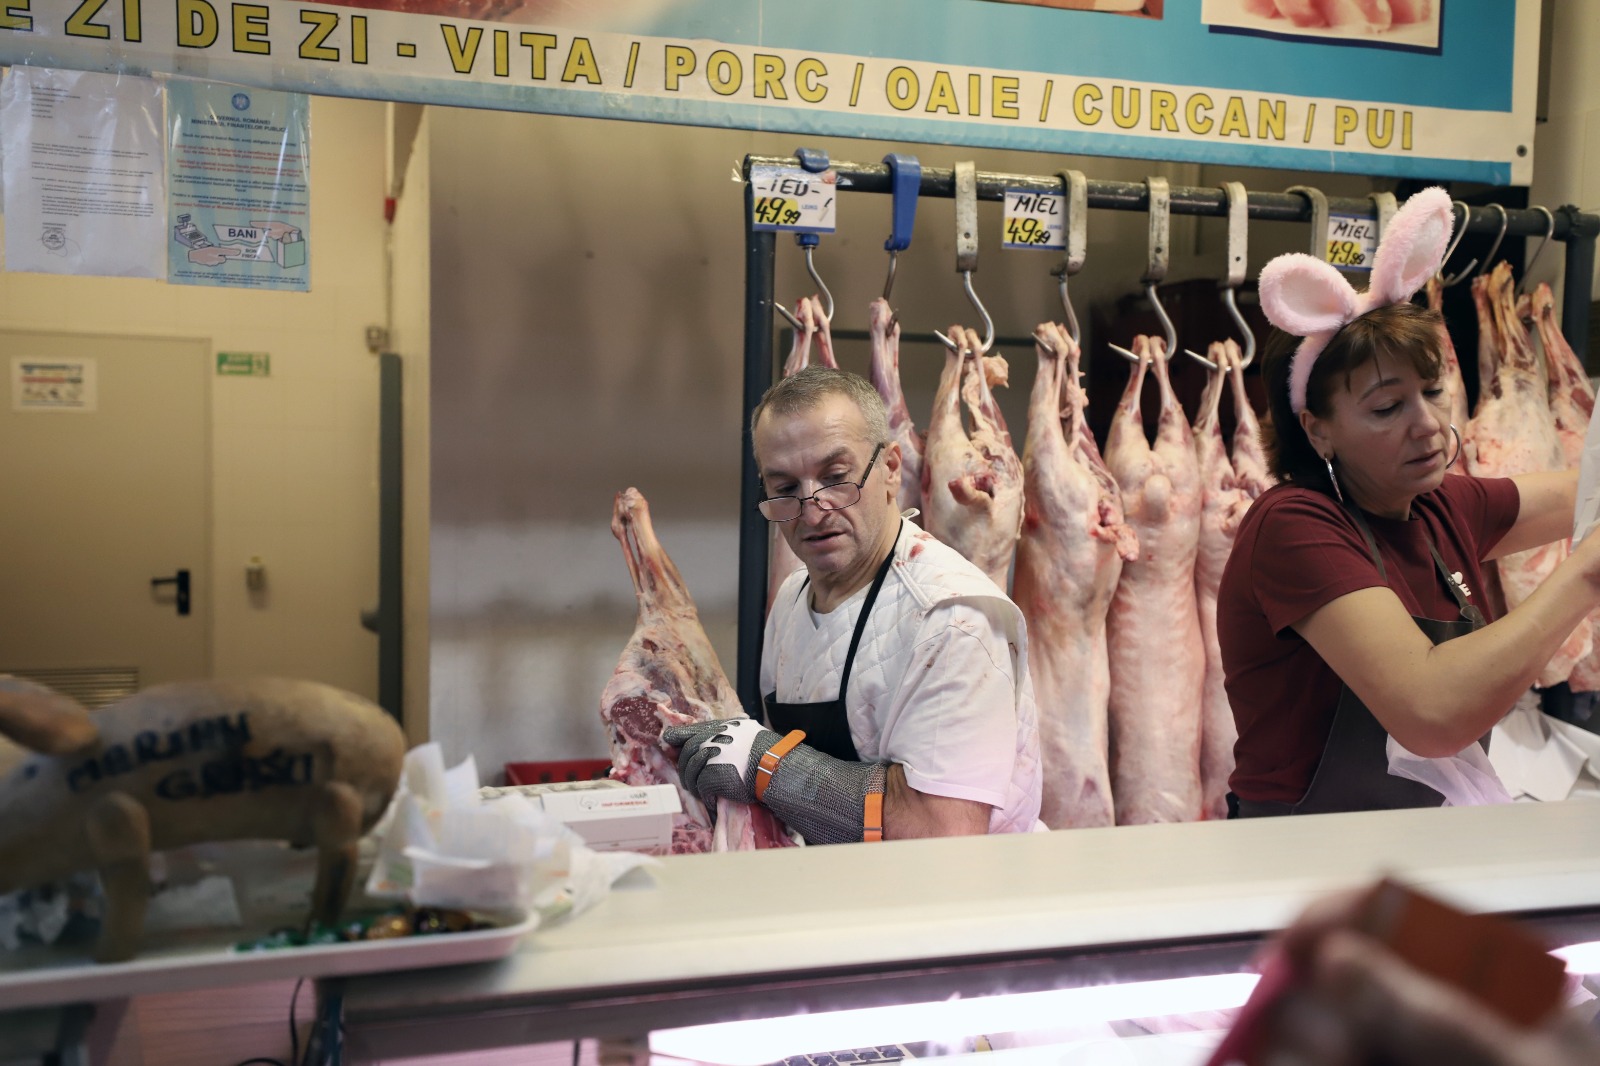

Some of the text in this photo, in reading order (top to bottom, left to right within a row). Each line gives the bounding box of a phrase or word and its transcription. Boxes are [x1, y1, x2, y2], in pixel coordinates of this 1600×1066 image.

[65, 0, 142, 42] ZI
[176, 0, 271, 55] DE
[298, 9, 368, 64] ZI
[396, 42, 417, 58] -
[440, 23, 602, 84] VITA
[623, 41, 640, 88] /
[664, 45, 828, 103] PORC
[849, 62, 864, 107] /
[885, 66, 1020, 119] OAIE
[1039, 79, 1053, 122] /
[1072, 83, 1286, 140] CURCAN
[1303, 103, 1317, 143] /
[1334, 105, 1413, 150] PUI
[228, 228, 257, 239] BANI
